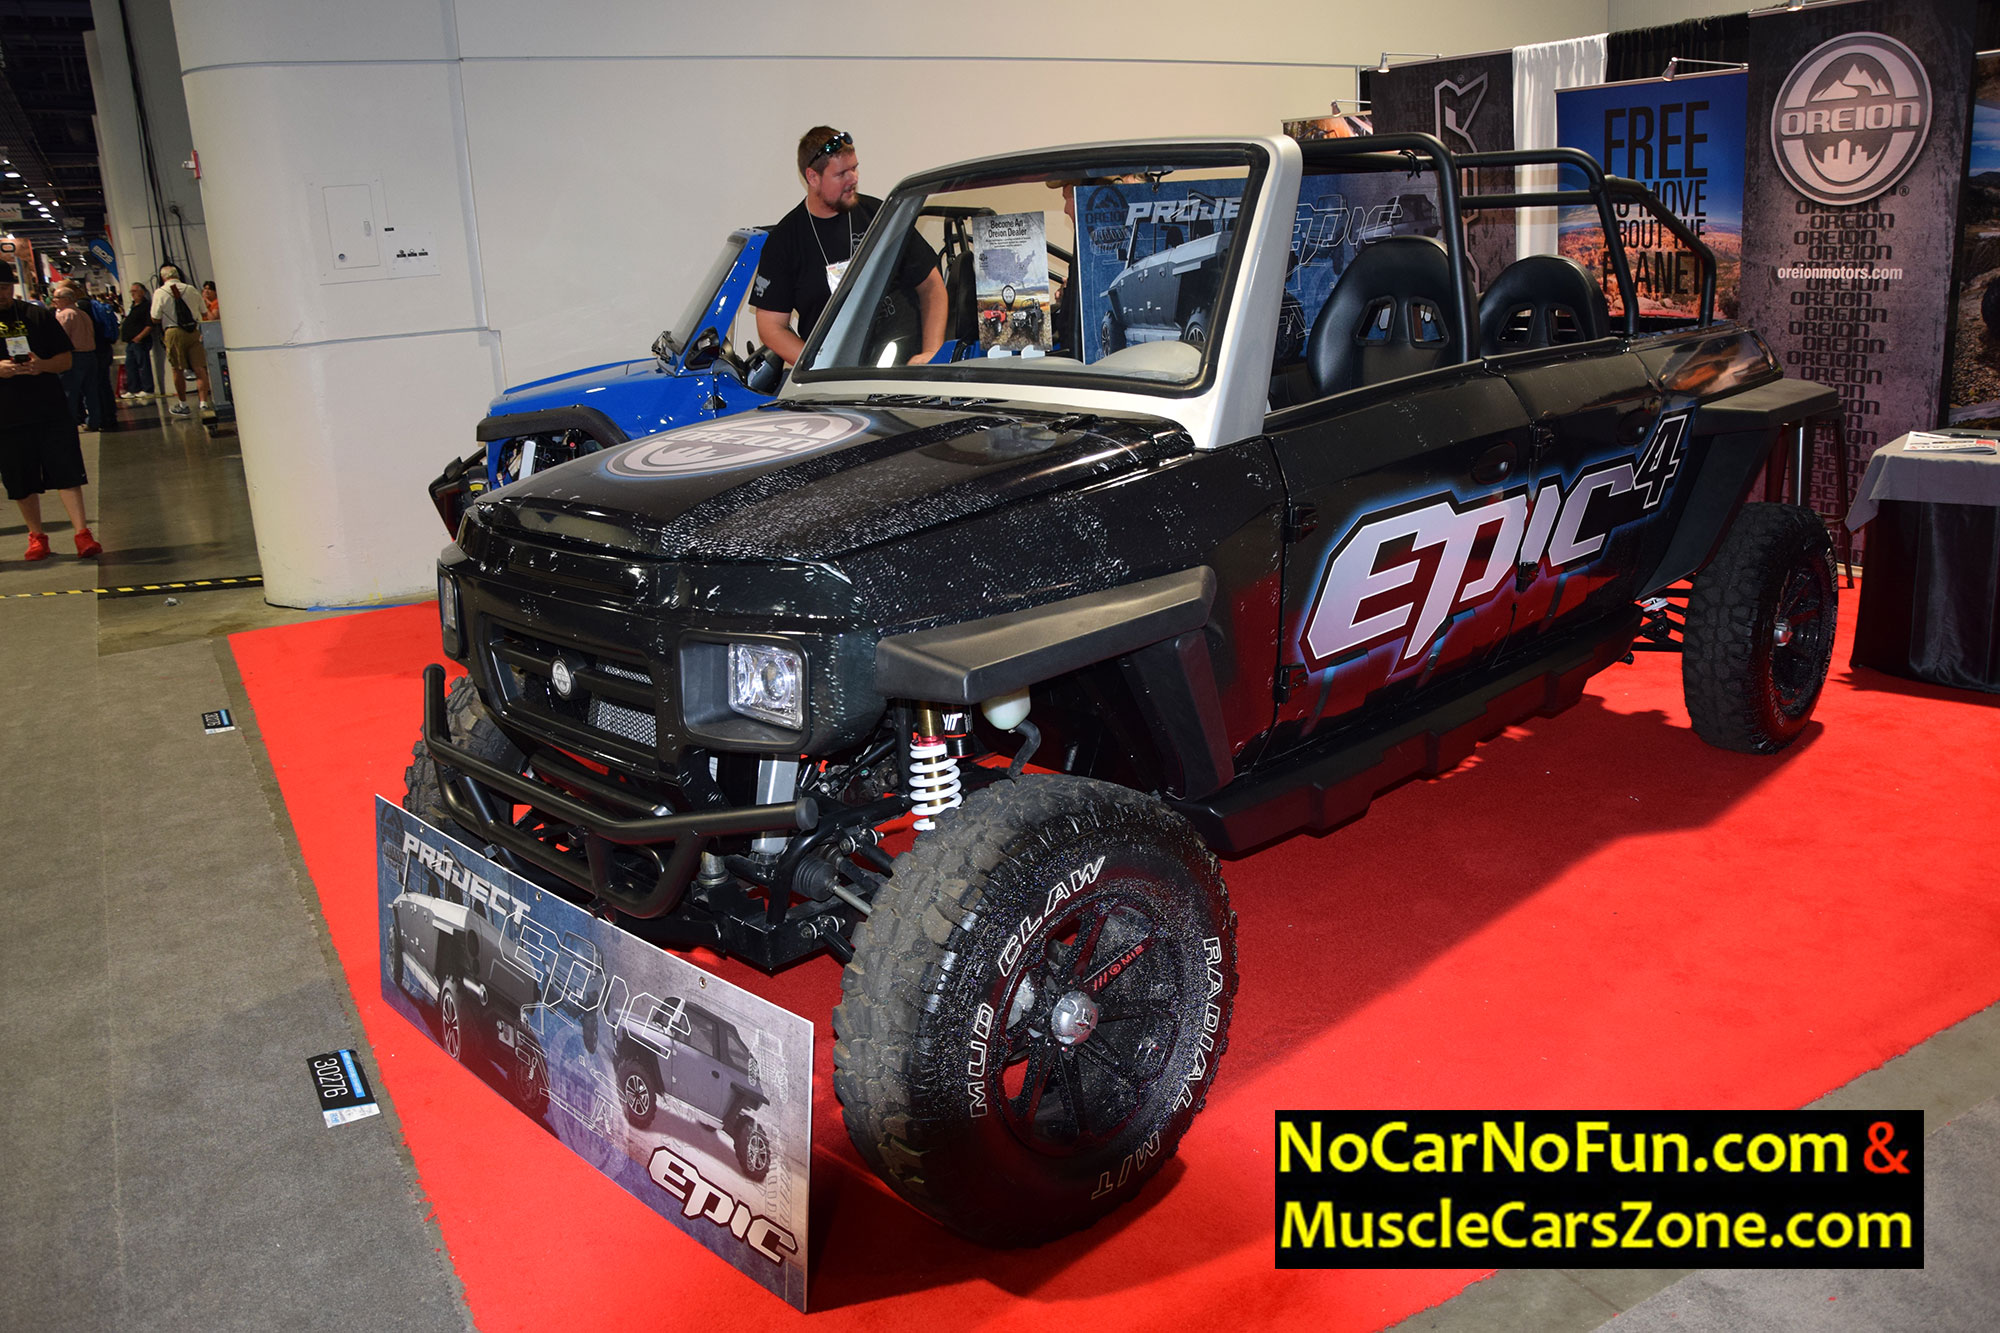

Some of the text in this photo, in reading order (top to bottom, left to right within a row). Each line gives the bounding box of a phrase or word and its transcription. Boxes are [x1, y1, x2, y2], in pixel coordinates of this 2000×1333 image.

[1781, 102, 1921, 136] OREION
[1602, 101, 1709, 180] FREE
[1810, 213, 1895, 229] OREION
[1604, 219, 1668, 249] BOUT
[1793, 230, 1877, 246] OREION
[1807, 245, 1892, 260] OREION
[1602, 250, 1704, 295] PANET
[1777, 264, 1903, 280] oreionmotors.com
[1790, 291, 1872, 307] OREION
[1788, 321, 1870, 338] OREION
[1802, 336, 1885, 354] OREION
[1786, 350, 1868, 369] OREION
[1800, 366, 1882, 385] OREION
[664, 430, 823, 451] OREION
[1306, 463, 1637, 661] EPIC
[402, 831, 531, 925] PROJECT
[968, 856, 1223, 1201] MUD CLAW RADIAL M/T
[313, 1057, 349, 1098] 30276
[648, 1146, 798, 1263] EPIC
